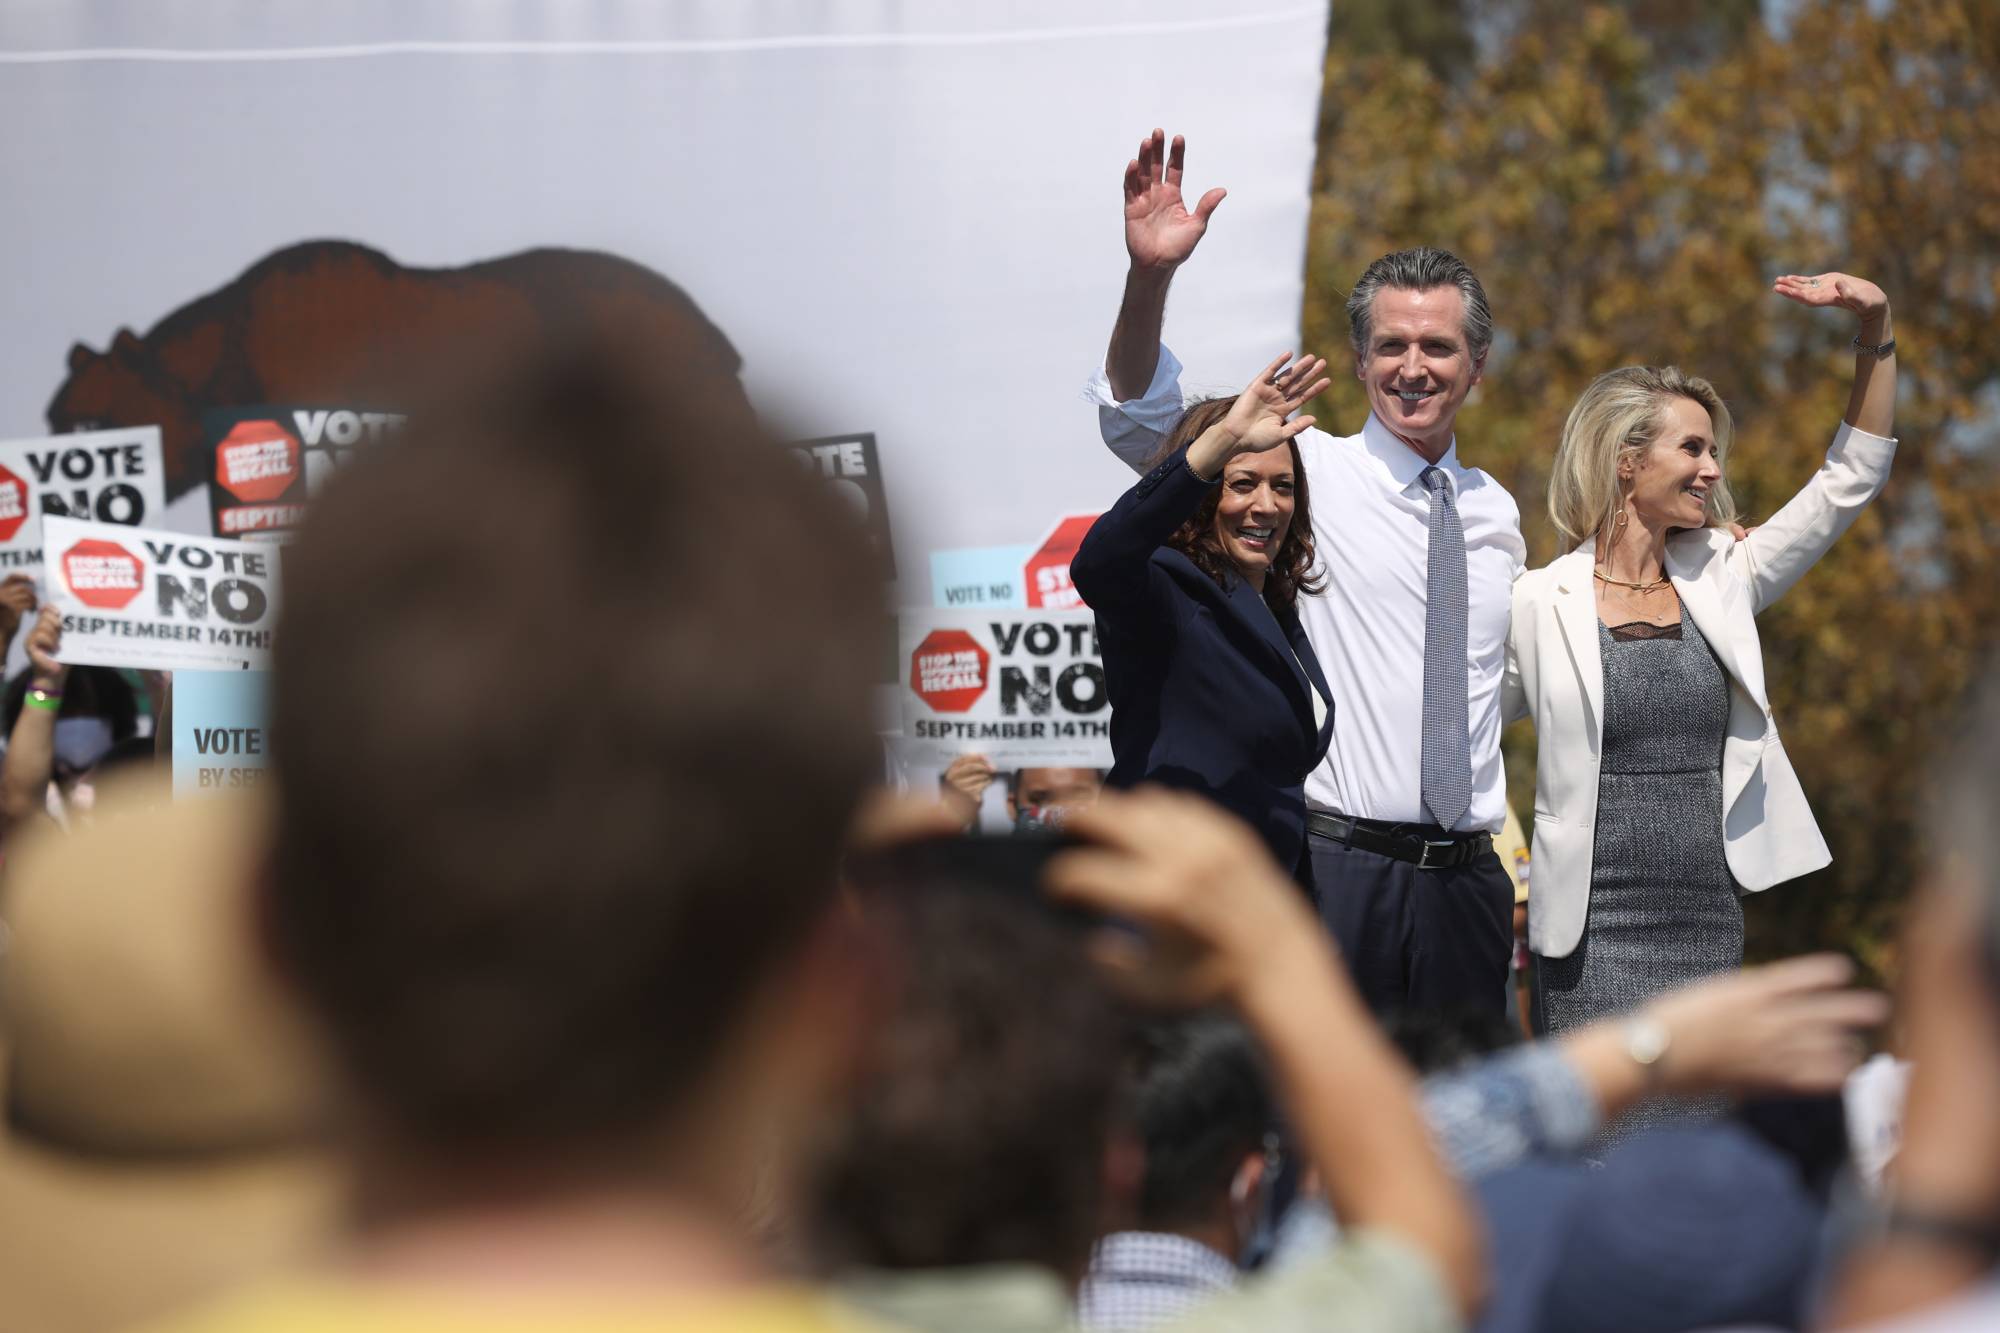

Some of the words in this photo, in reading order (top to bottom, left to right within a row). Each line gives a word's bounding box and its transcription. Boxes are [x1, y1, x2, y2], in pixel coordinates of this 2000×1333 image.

[26, 444, 145, 484] VOTE
[788, 441, 868, 477] TE
[40, 483, 145, 526] NO
[221, 505, 304, 533] SEPTE
[143, 540, 267, 579] VOTE
[155, 574, 268, 625] NO
[944, 585, 984, 606] VOTE
[990, 583, 1012, 601] NO
[61, 615, 201, 644] SEPTEMBER
[208, 627, 271, 649] 14TH!
[922, 672, 982, 693] RECALL
[1001, 662, 1109, 715] NO
[193, 727, 261, 756] VOTE
[915, 720, 1045, 739] SEPTEMBER
[198, 767, 225, 789] BY
